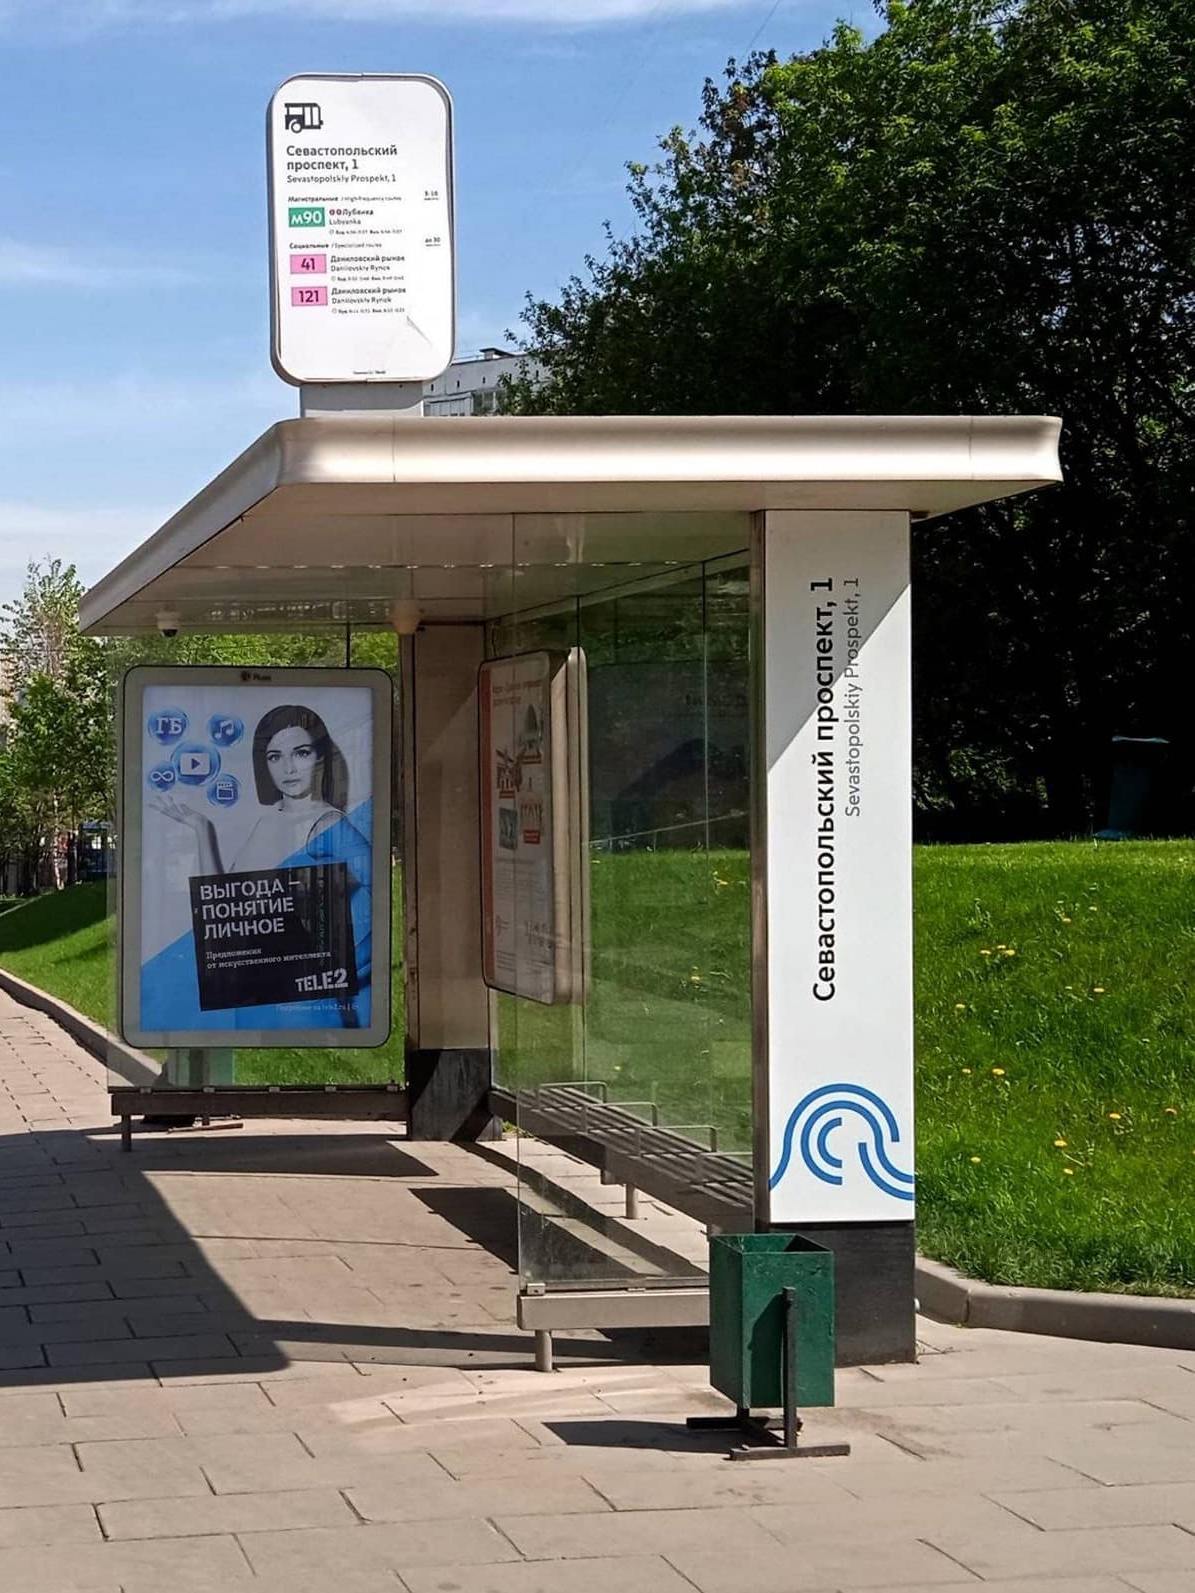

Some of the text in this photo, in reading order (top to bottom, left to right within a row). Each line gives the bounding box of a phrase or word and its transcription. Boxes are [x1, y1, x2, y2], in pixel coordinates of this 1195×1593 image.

[286, 144, 398, 157] Севастопольский
[286, 159, 359, 172] проспект, 1
[391, 173, 396, 182] 1
[301, 257, 316, 271] 41
[299, 290, 319, 303] 121
[843, 578, 863, 818] Sevastopolskiy Prospekt, 1
[155, 717, 184, 735] ГБ
[810, 577, 839, 1002] Севастопольский проспект, 1
[199, 878, 285, 900] ВЫГОДА
[201, 896, 295, 921] ПОНЯТИЕ
[204, 917, 285, 940] ЛИЧНОЕ
[207, 961, 217, 970] от
[295, 967, 348, 992] TELE2
